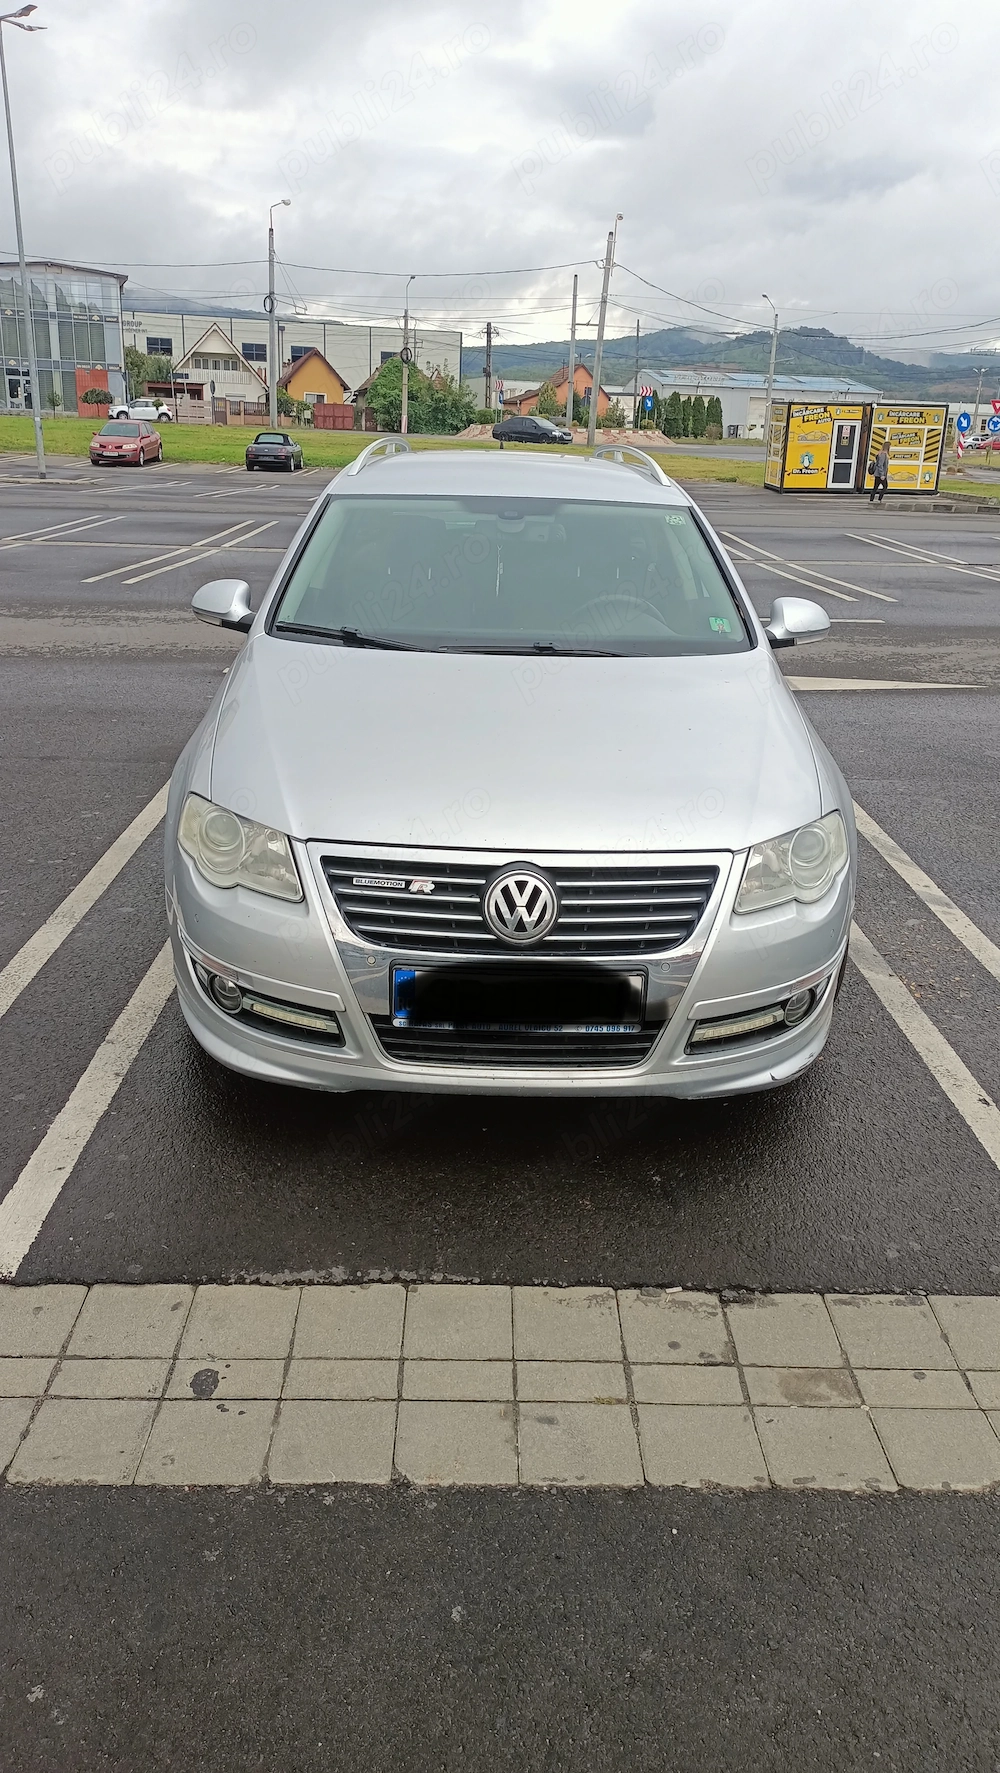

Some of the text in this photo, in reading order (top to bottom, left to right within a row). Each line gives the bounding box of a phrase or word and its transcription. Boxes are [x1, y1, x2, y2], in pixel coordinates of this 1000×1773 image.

[804, 412, 830, 422] FREON
[355, 878, 404, 888] BLUEMOTION
[498, 1023, 521, 1031] AUREL
